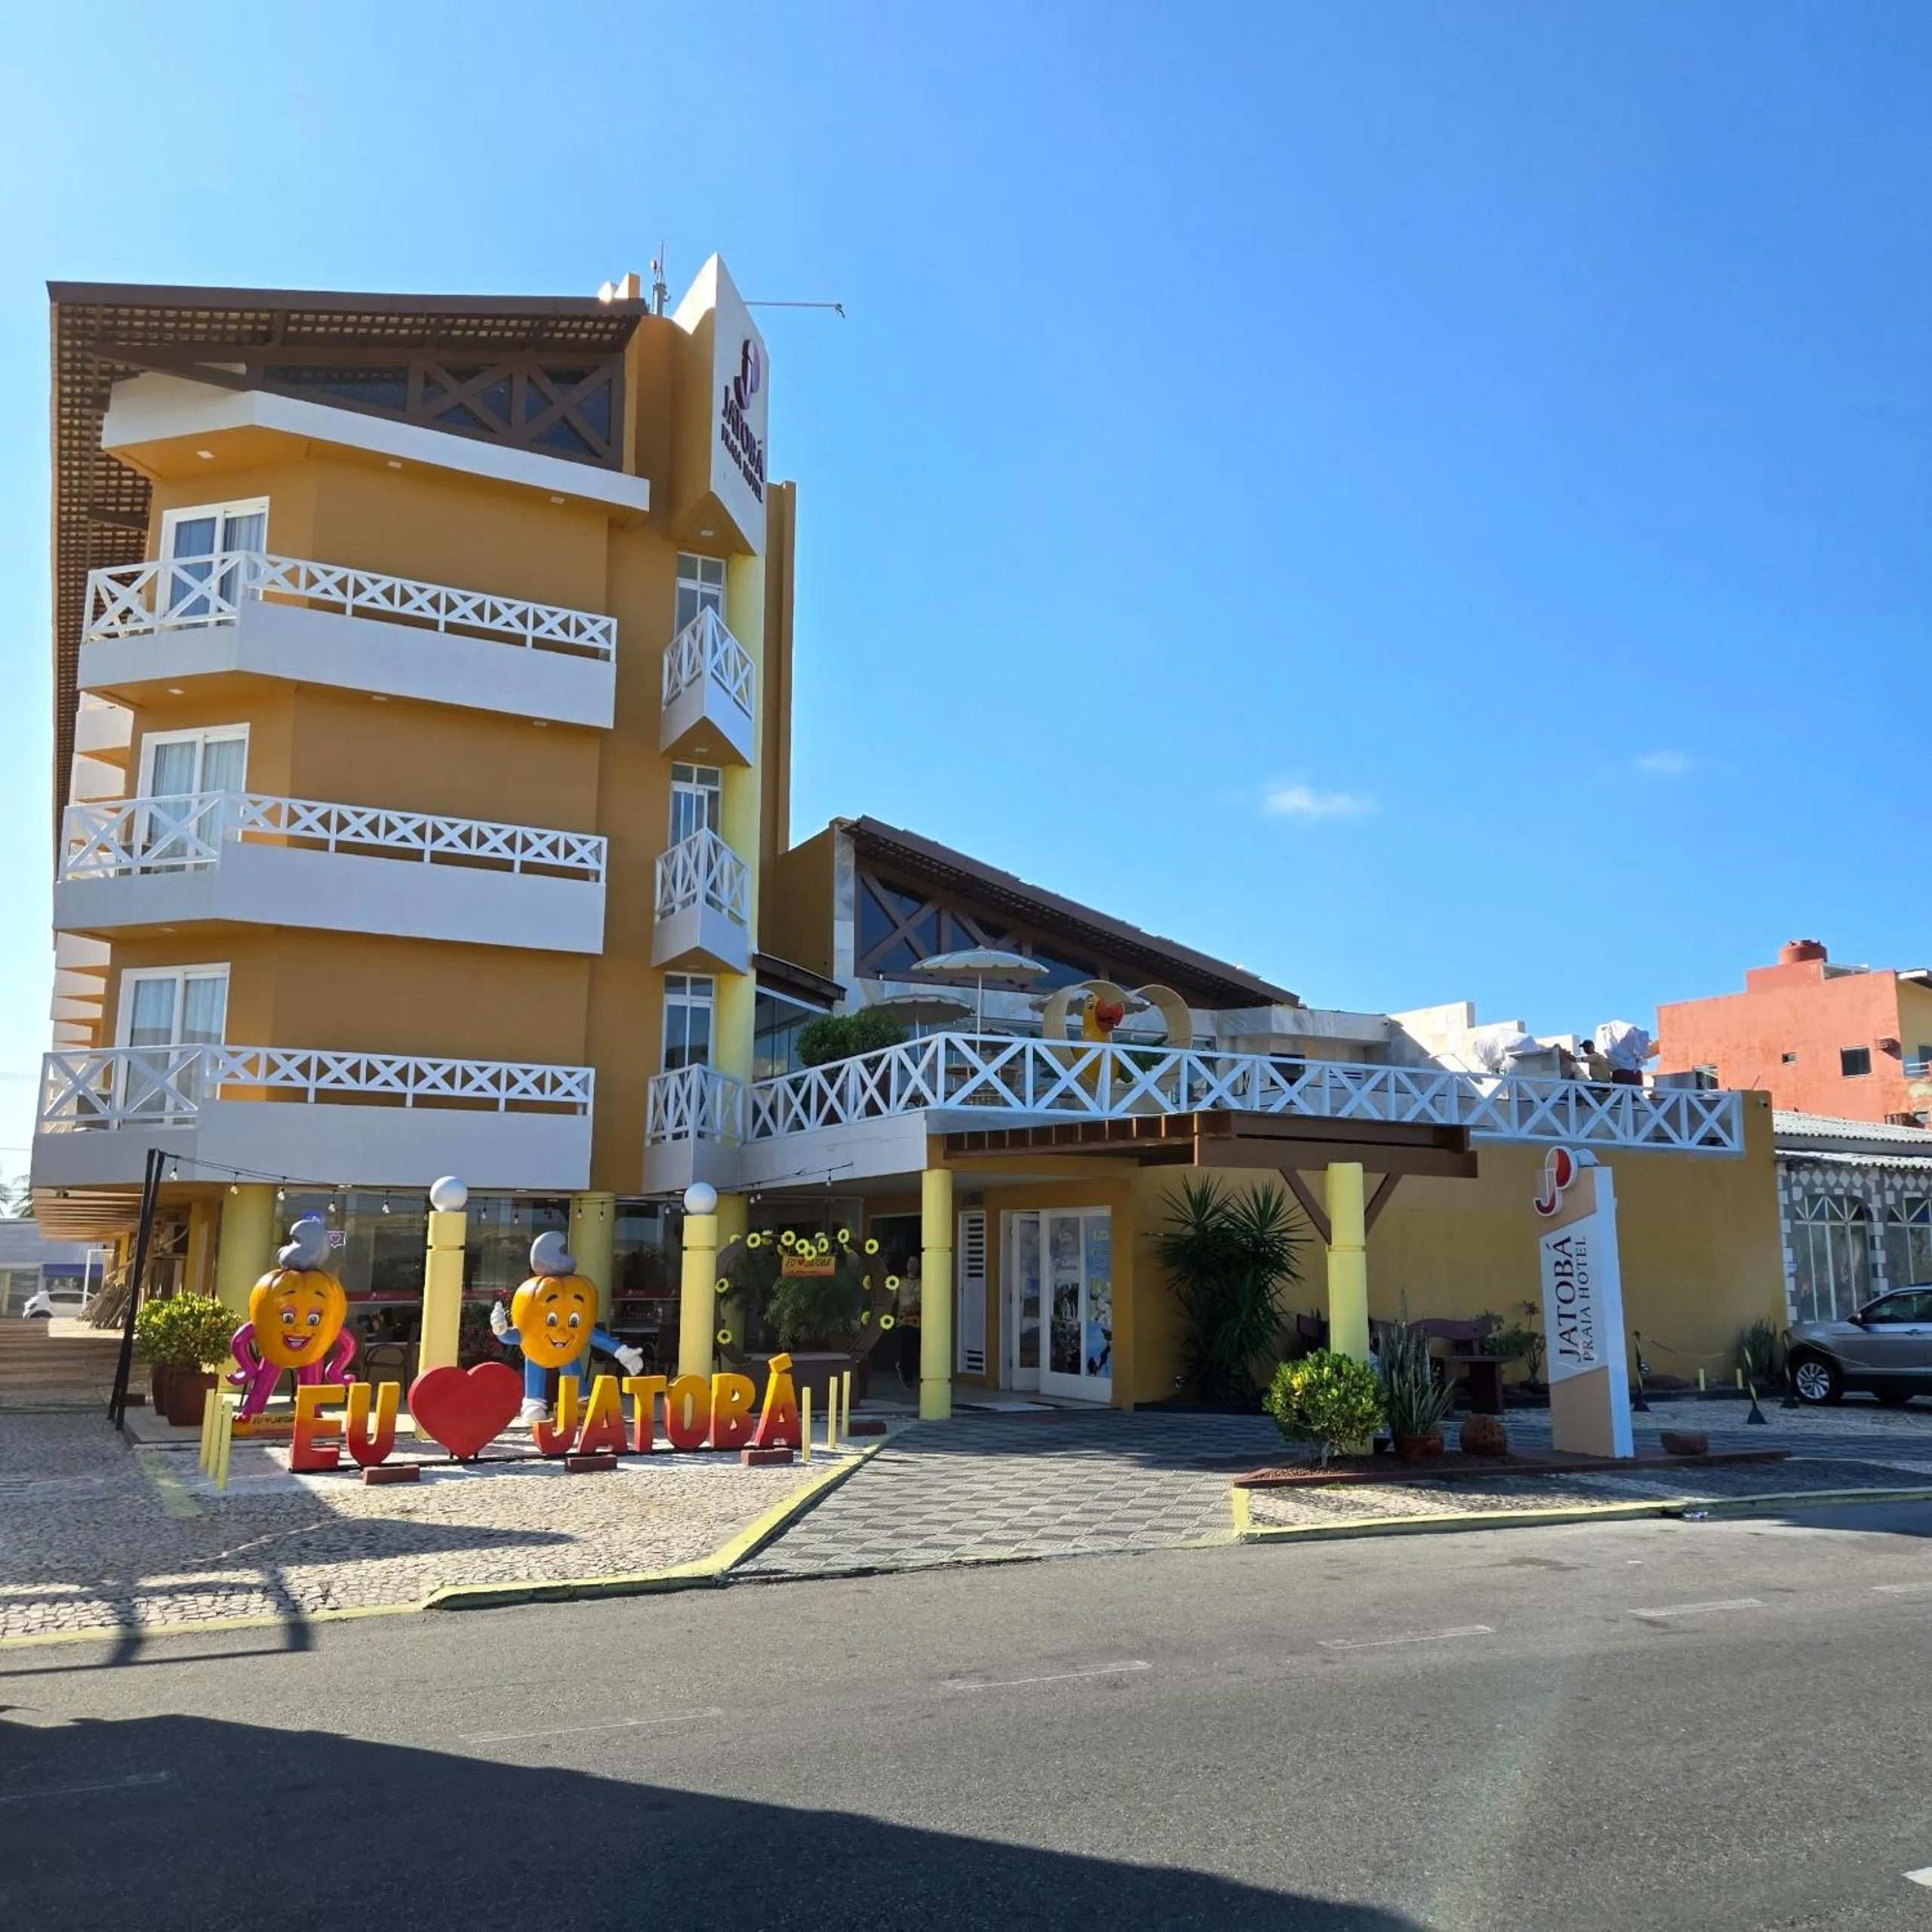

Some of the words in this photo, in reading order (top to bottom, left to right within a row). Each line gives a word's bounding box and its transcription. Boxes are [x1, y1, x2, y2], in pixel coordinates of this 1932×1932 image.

[1546, 1236, 1581, 1362] JATOBÁ
[1576, 1236, 1590, 1298] HOTEL
[1580, 1306, 1594, 1361] PRAIA
[289, 1382, 400, 1473] EU
[533, 1353, 802, 1455] JATOBÁ
